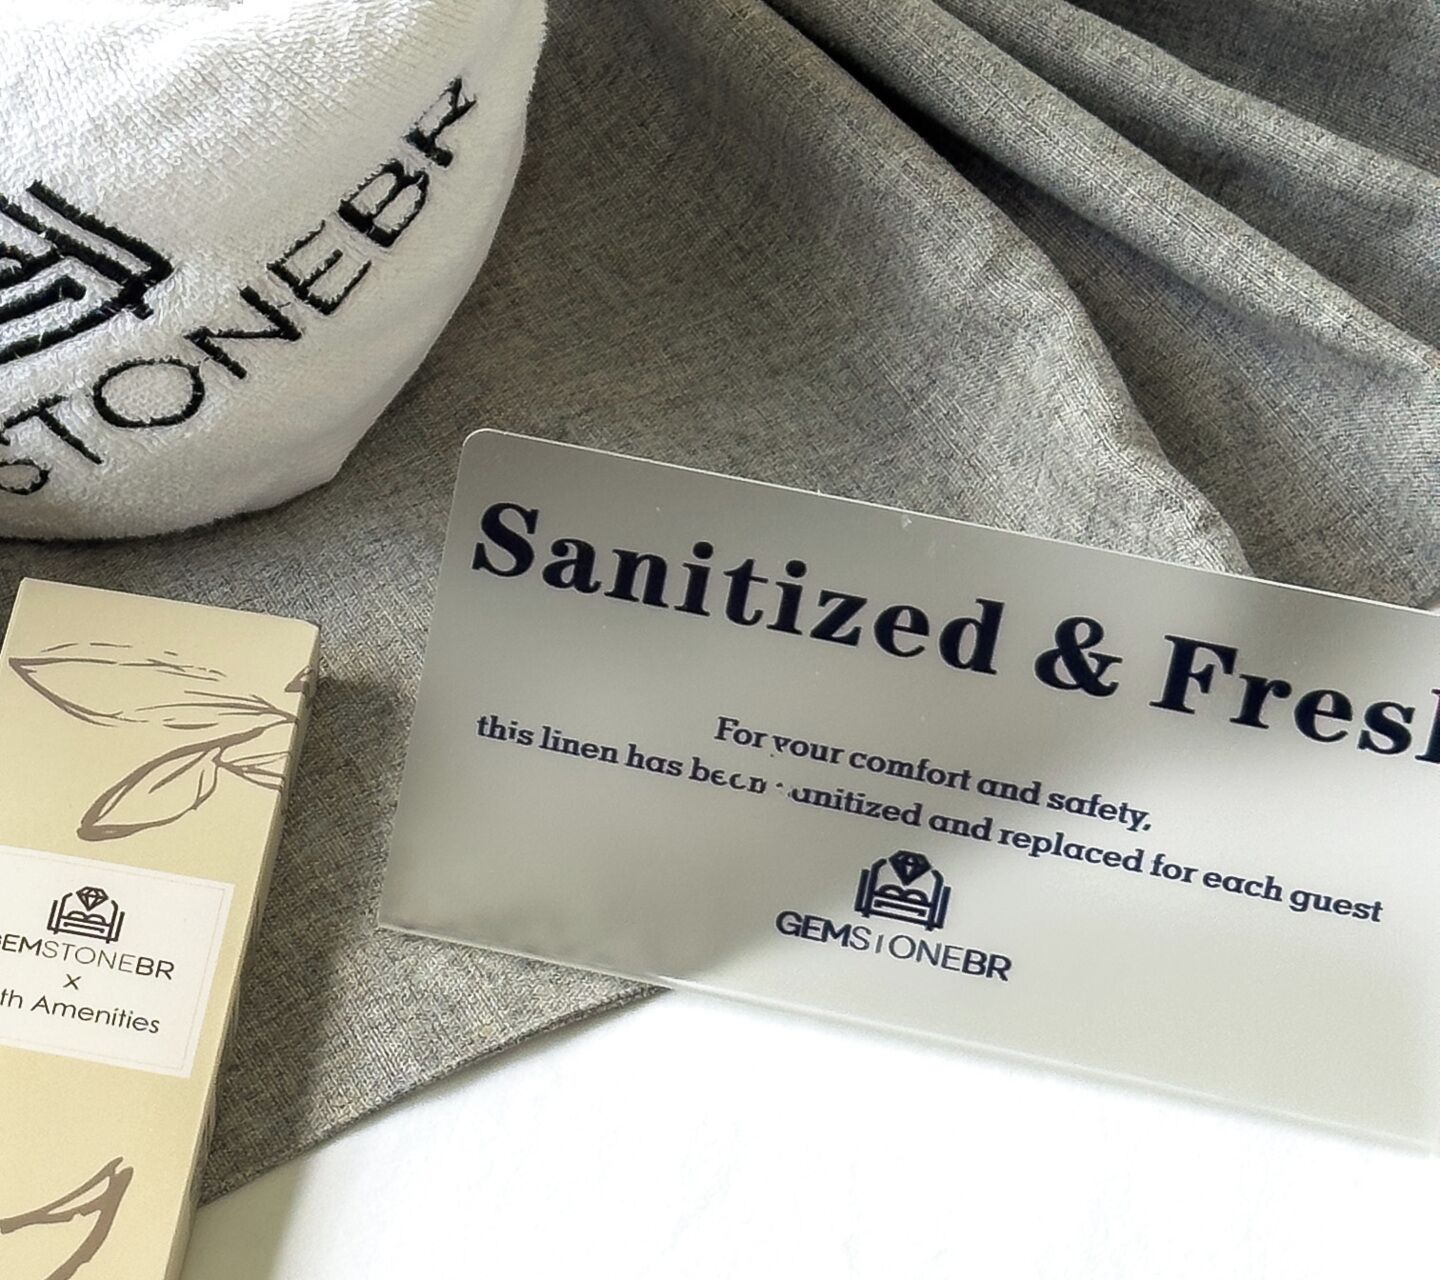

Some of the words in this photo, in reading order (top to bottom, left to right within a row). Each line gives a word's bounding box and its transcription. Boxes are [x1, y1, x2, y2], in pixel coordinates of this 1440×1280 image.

[471, 501, 1005, 675] Sanitized
[1033, 616, 1123, 698] &
[476, 715, 534, 746] this
[539, 726, 619, 764] linen
[624, 744, 684, 776] has
[776, 782, 922, 827] anitized
[928, 812, 992, 842] and
[998, 827, 1144, 874] replaced
[1150, 852, 1198, 883] for
[1202, 871, 1282, 902] each
[1289, 889, 1383, 923] guest
[714, 716, 768, 748] For
[848, 750, 971, 791] comfort
[976, 775, 1042, 806] and
[1047, 791, 1153, 832] safety,
[31, 995, 161, 1034] Amenities
